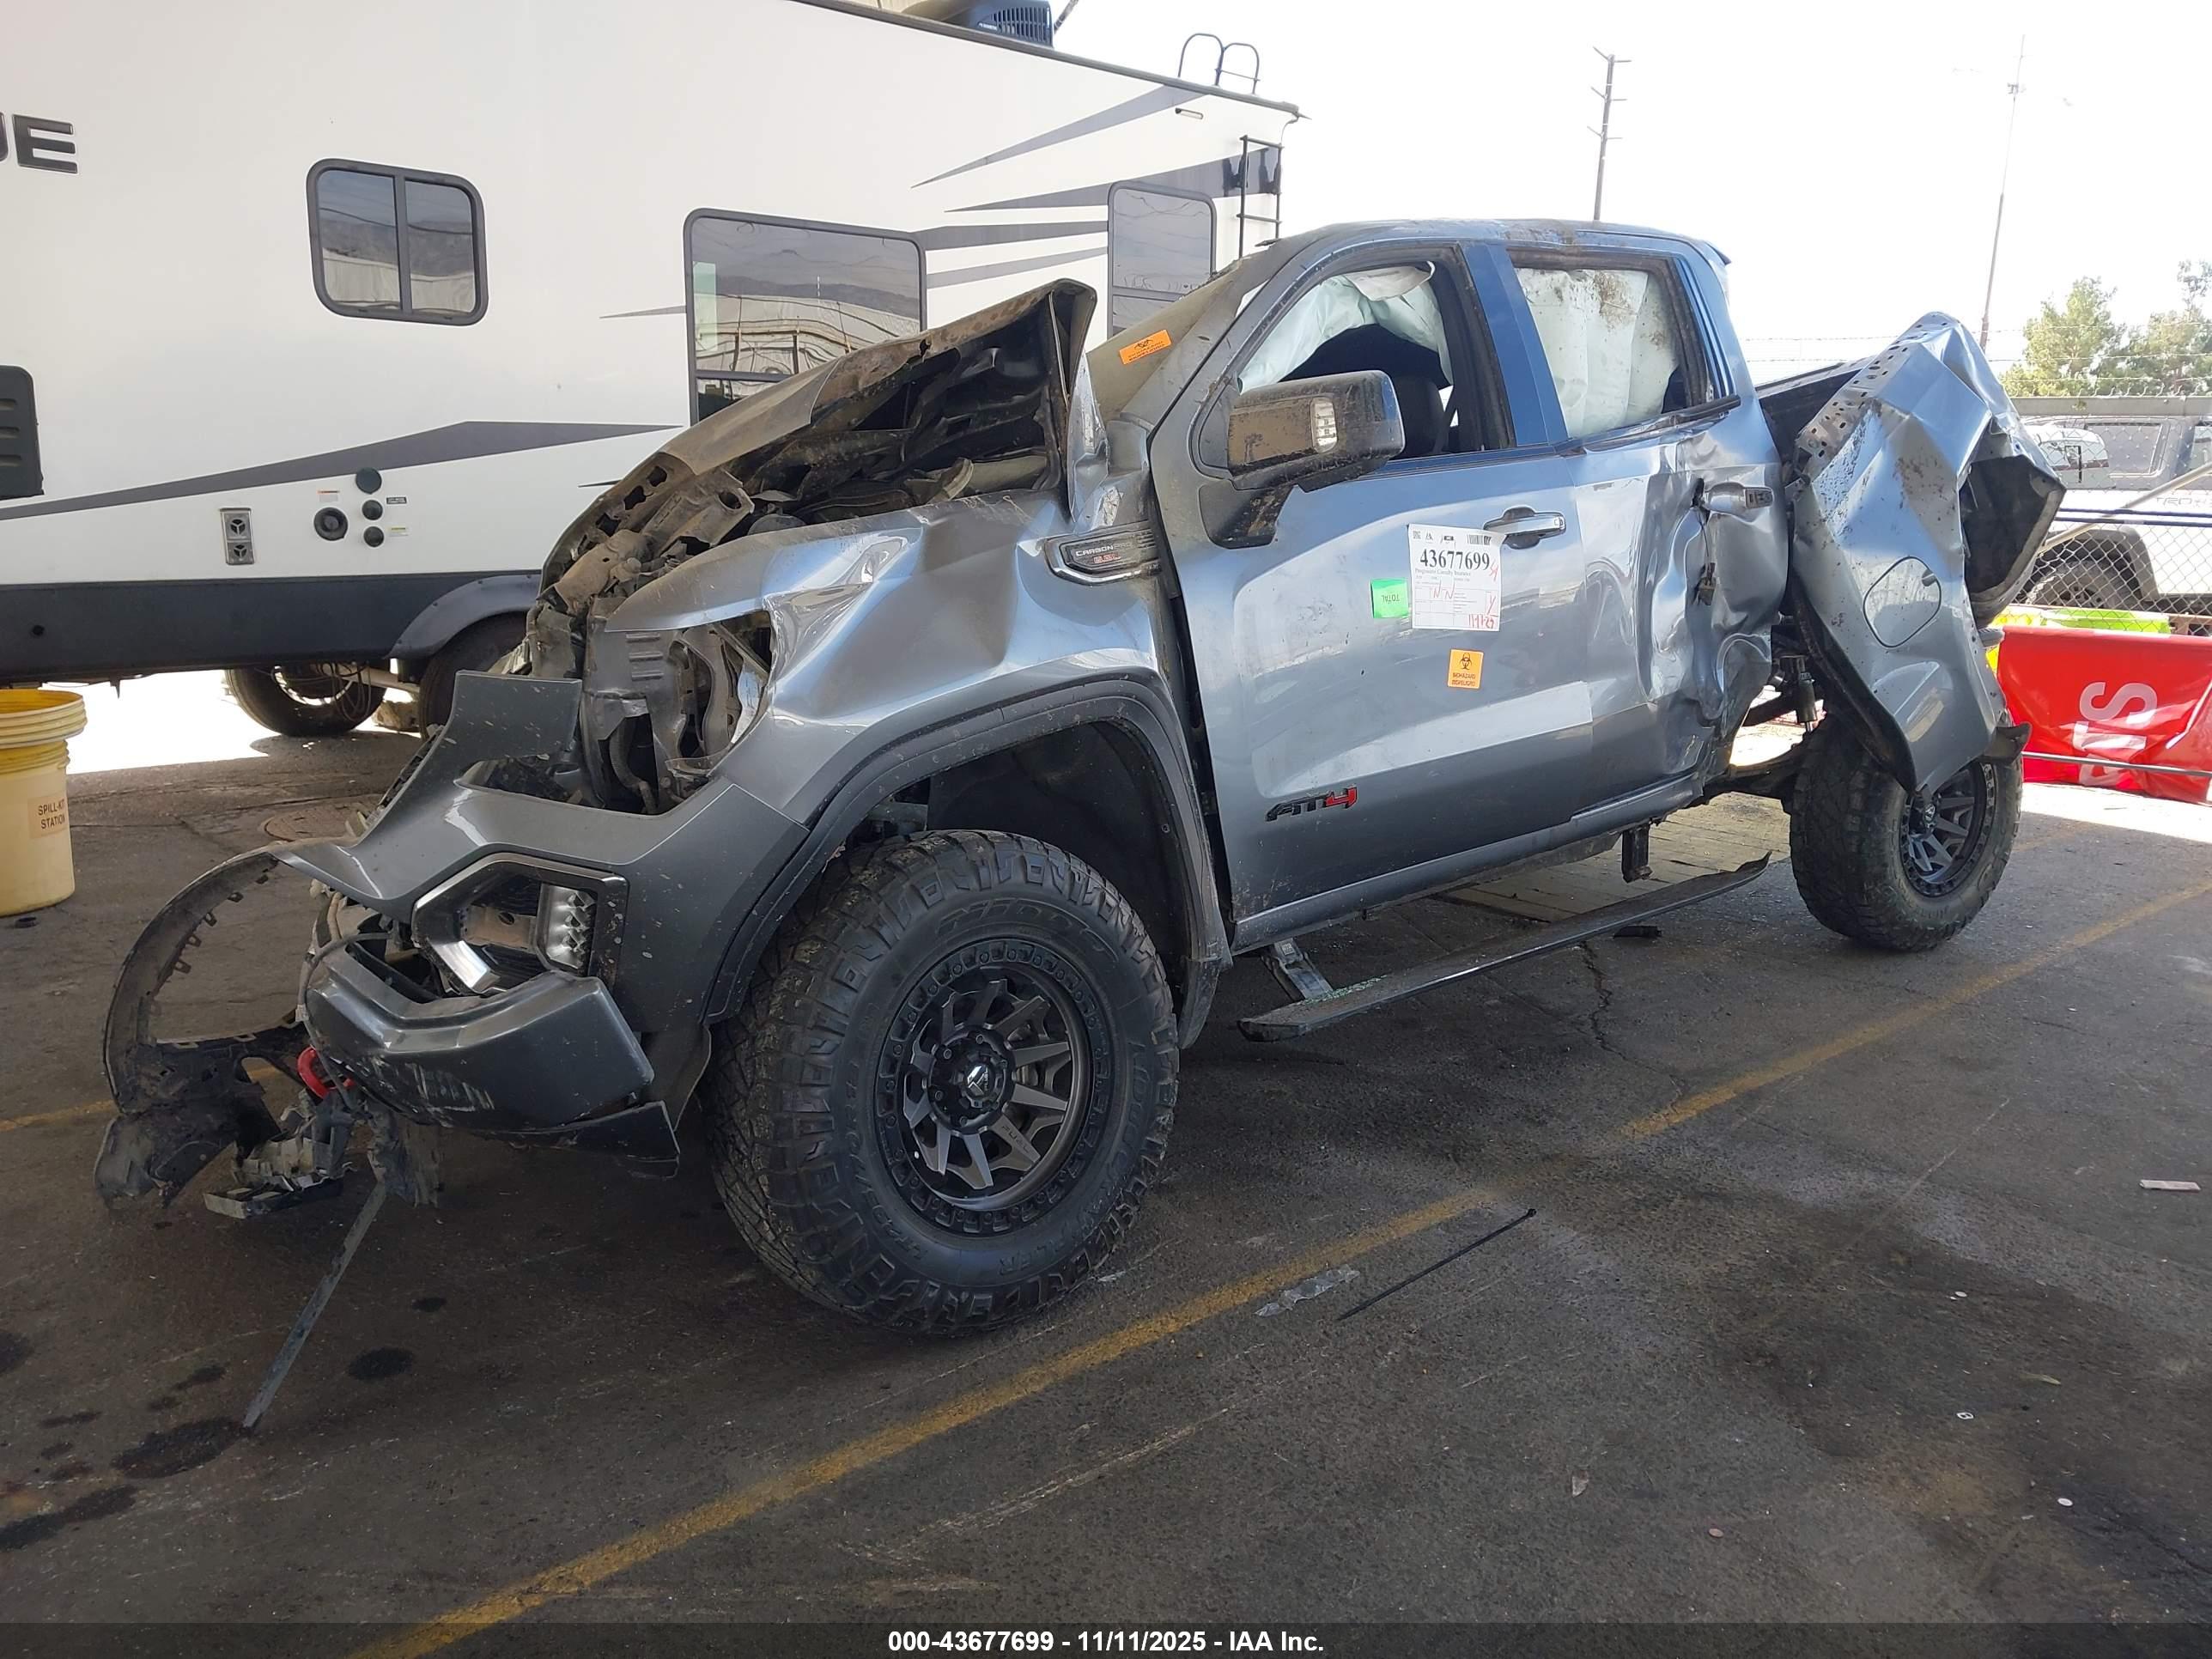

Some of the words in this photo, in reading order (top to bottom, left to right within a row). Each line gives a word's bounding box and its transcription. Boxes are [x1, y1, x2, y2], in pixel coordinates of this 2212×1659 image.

[1419, 548, 1491, 571] 43677699
[1381, 593, 1401, 603] TOTAL
[40, 813, 65, 830] STATION
